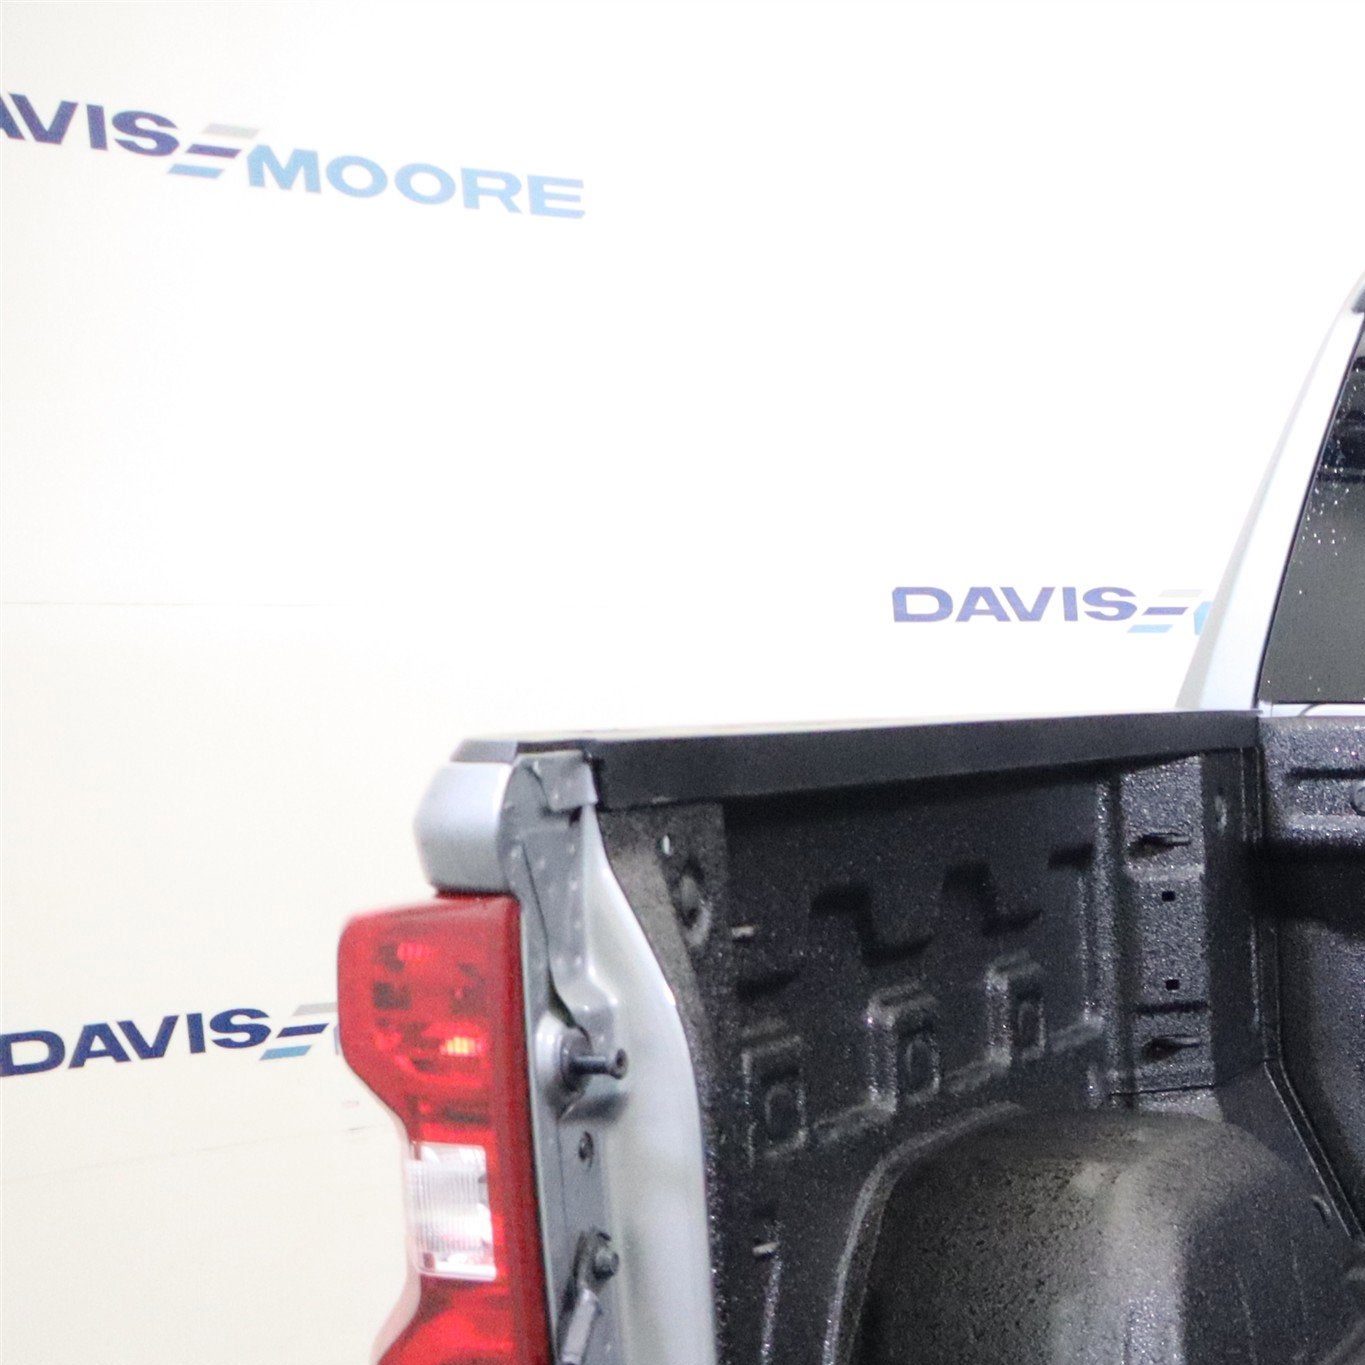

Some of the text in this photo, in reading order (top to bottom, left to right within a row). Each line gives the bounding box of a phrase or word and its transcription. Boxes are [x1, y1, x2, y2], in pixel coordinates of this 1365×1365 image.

[246, 144, 586, 219] MOORE
[891, 586, 1137, 622] DAVIS
[0, 1007, 271, 1077] DAVIS
